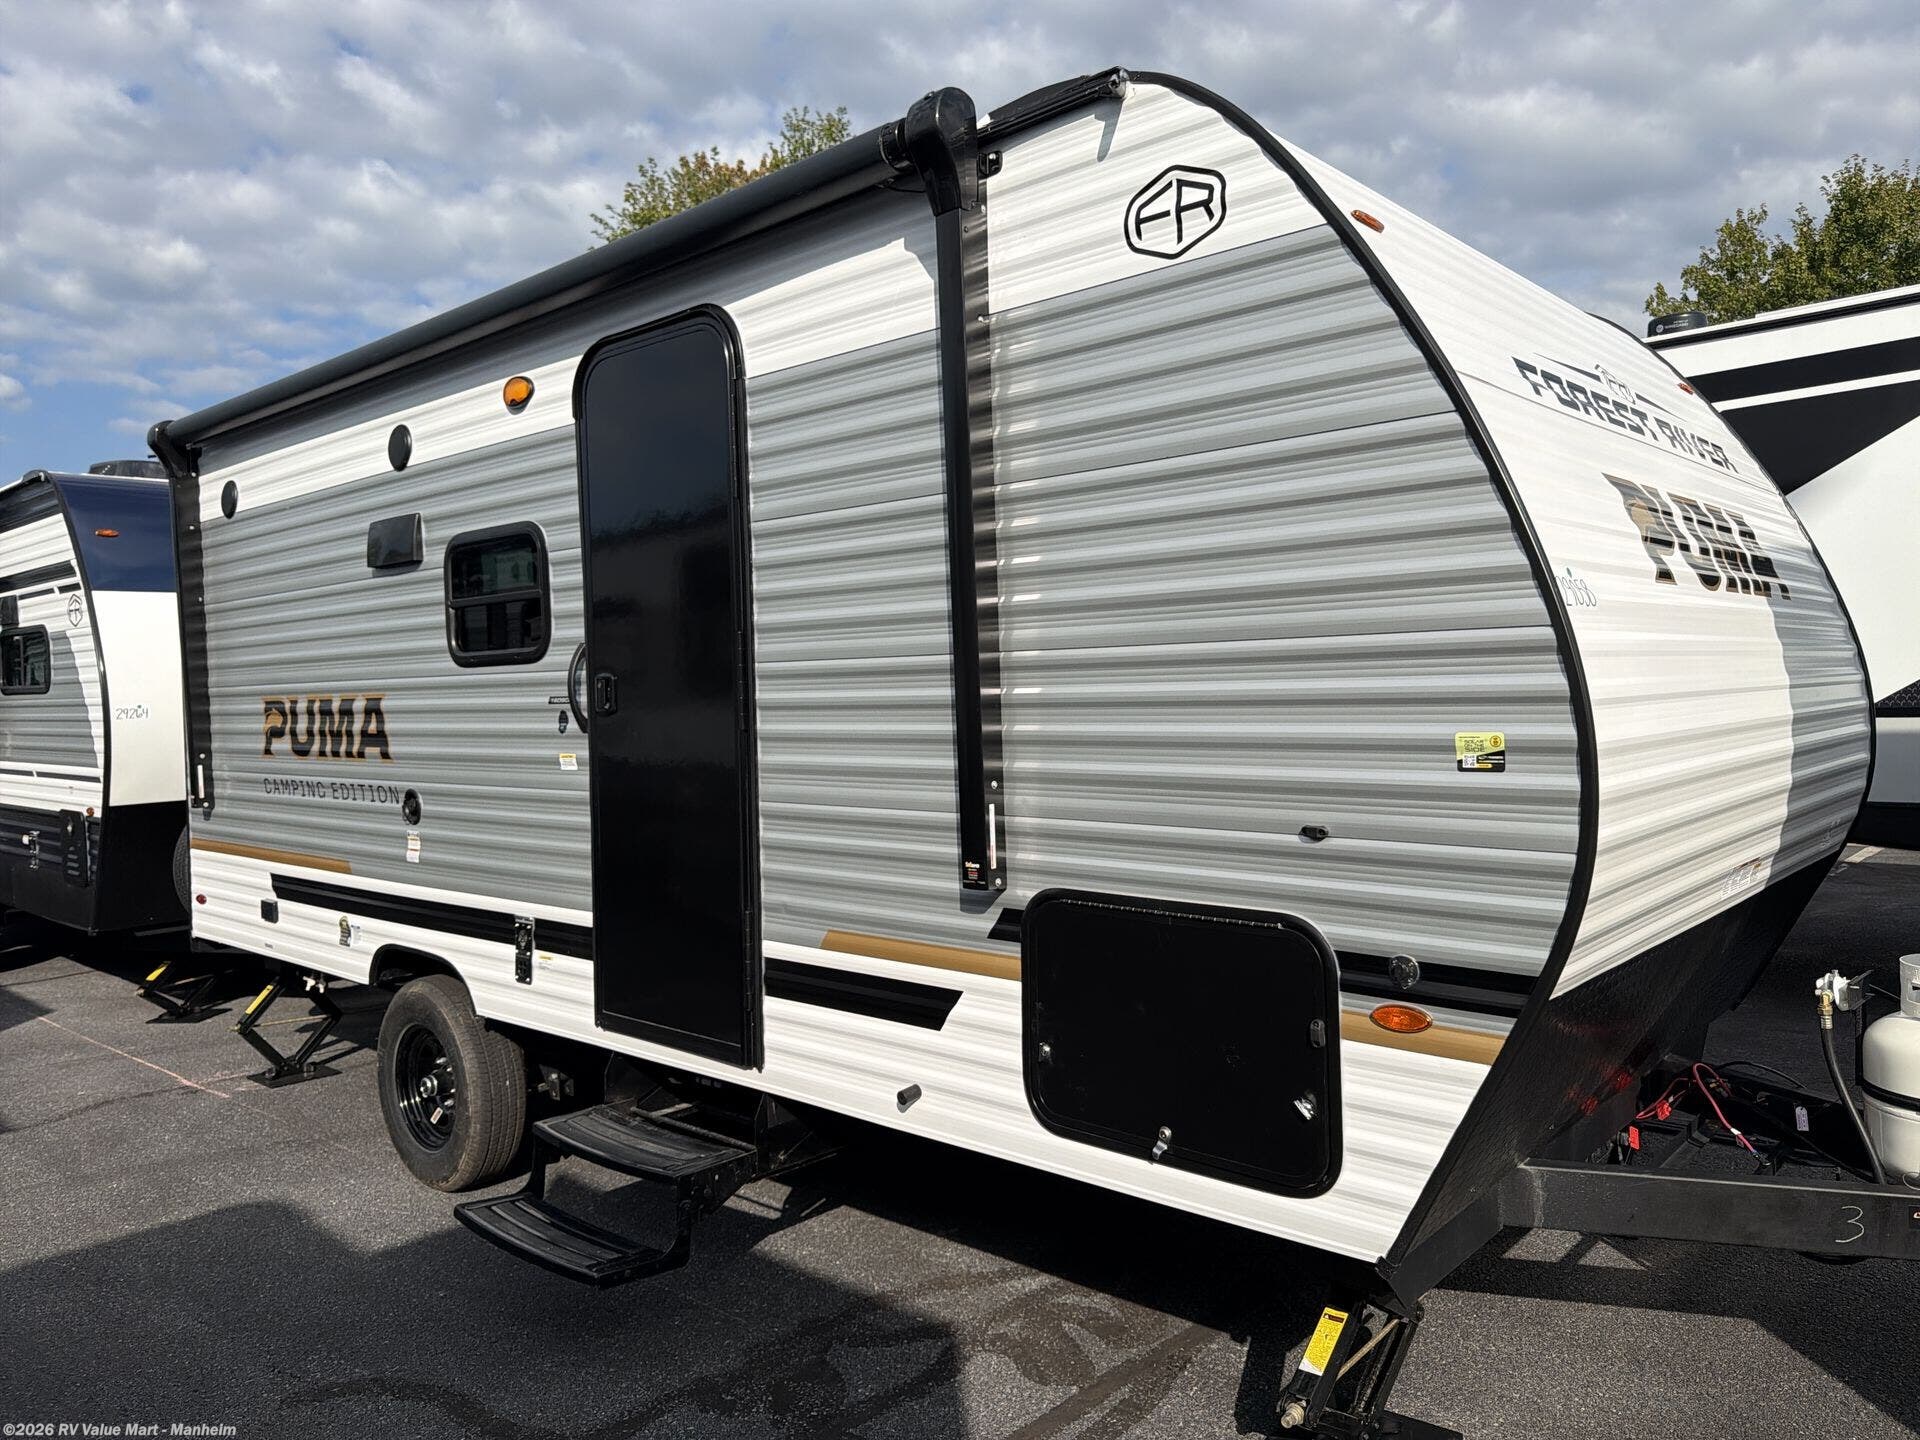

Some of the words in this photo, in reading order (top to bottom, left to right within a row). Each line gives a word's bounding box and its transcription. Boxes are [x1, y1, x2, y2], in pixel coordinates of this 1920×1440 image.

[1134, 177, 1215, 246] FR
[1511, 356, 1659, 442] FOREST
[1653, 416, 1739, 474] RIVER
[1601, 472, 1792, 601] PUMA
[261, 693, 396, 765] PUMA
[263, 777, 327, 799] CAMPING
[330, 782, 401, 805] EDITION
[1834, 1205, 1865, 1243] 3
